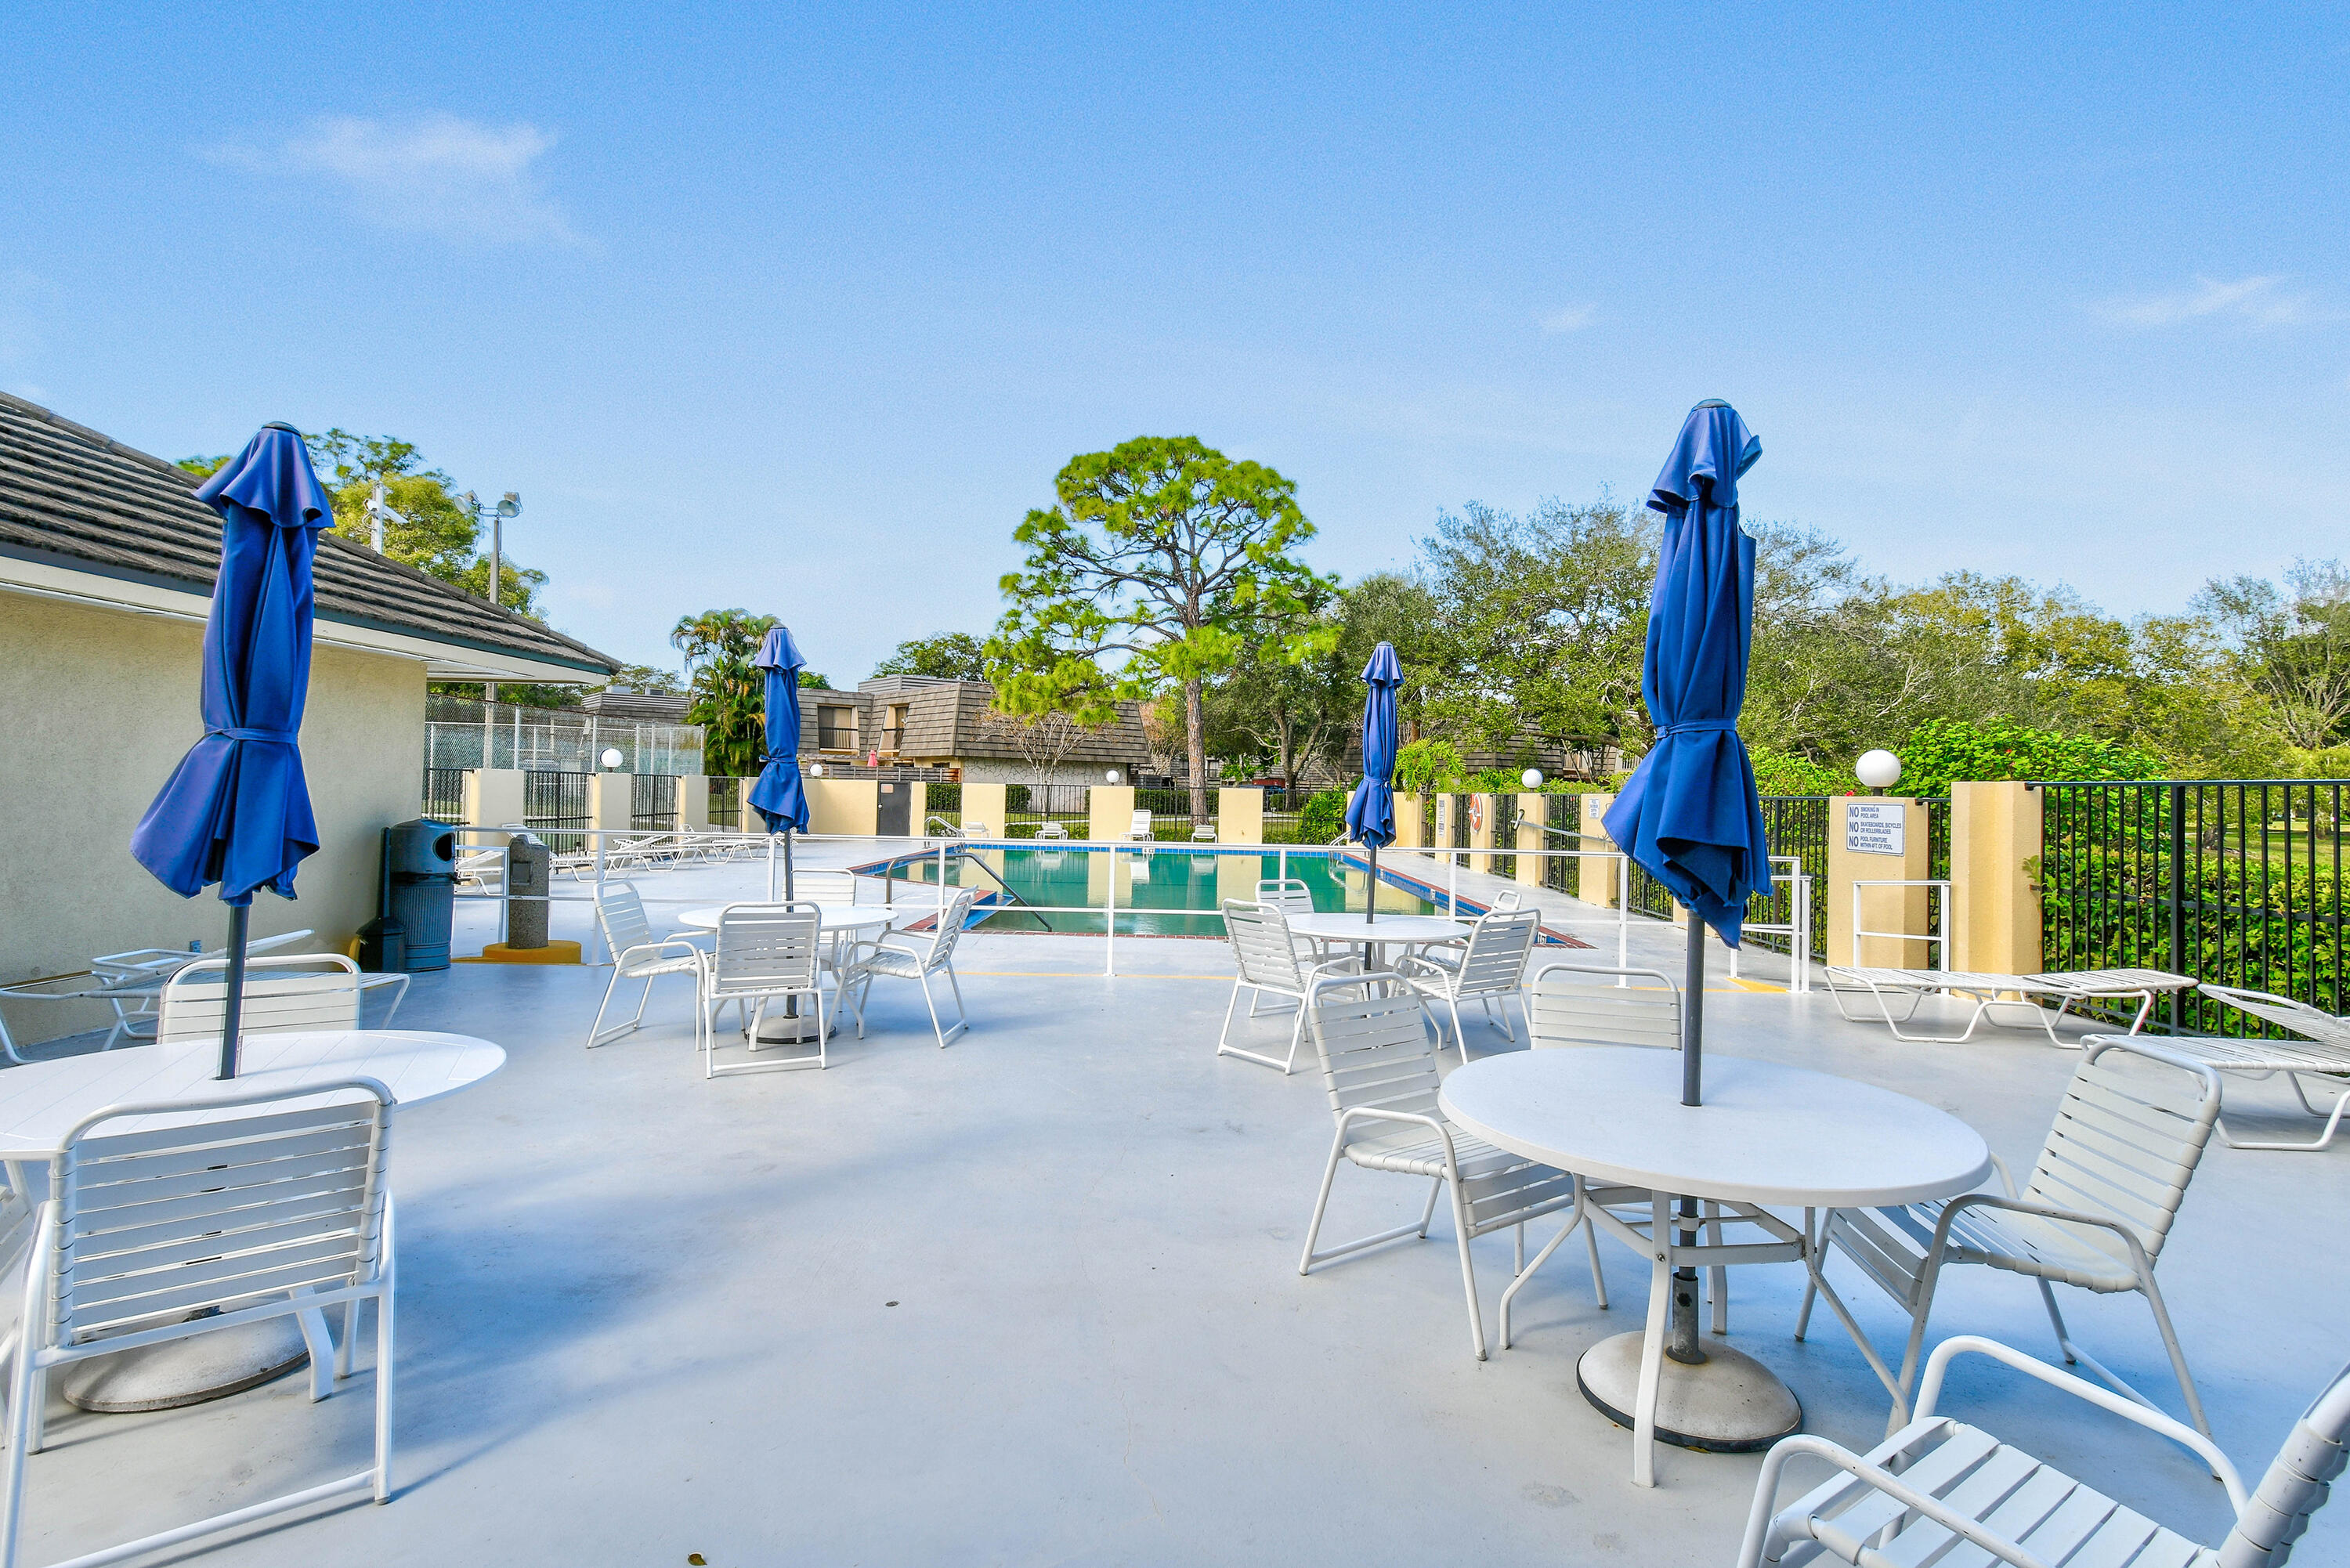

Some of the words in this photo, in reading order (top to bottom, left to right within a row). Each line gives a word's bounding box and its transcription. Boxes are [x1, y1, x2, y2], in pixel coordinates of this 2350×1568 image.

[1849, 807, 1859, 818] NO
[1849, 822, 1859, 833] NO
[1849, 836, 1859, 847] NO
